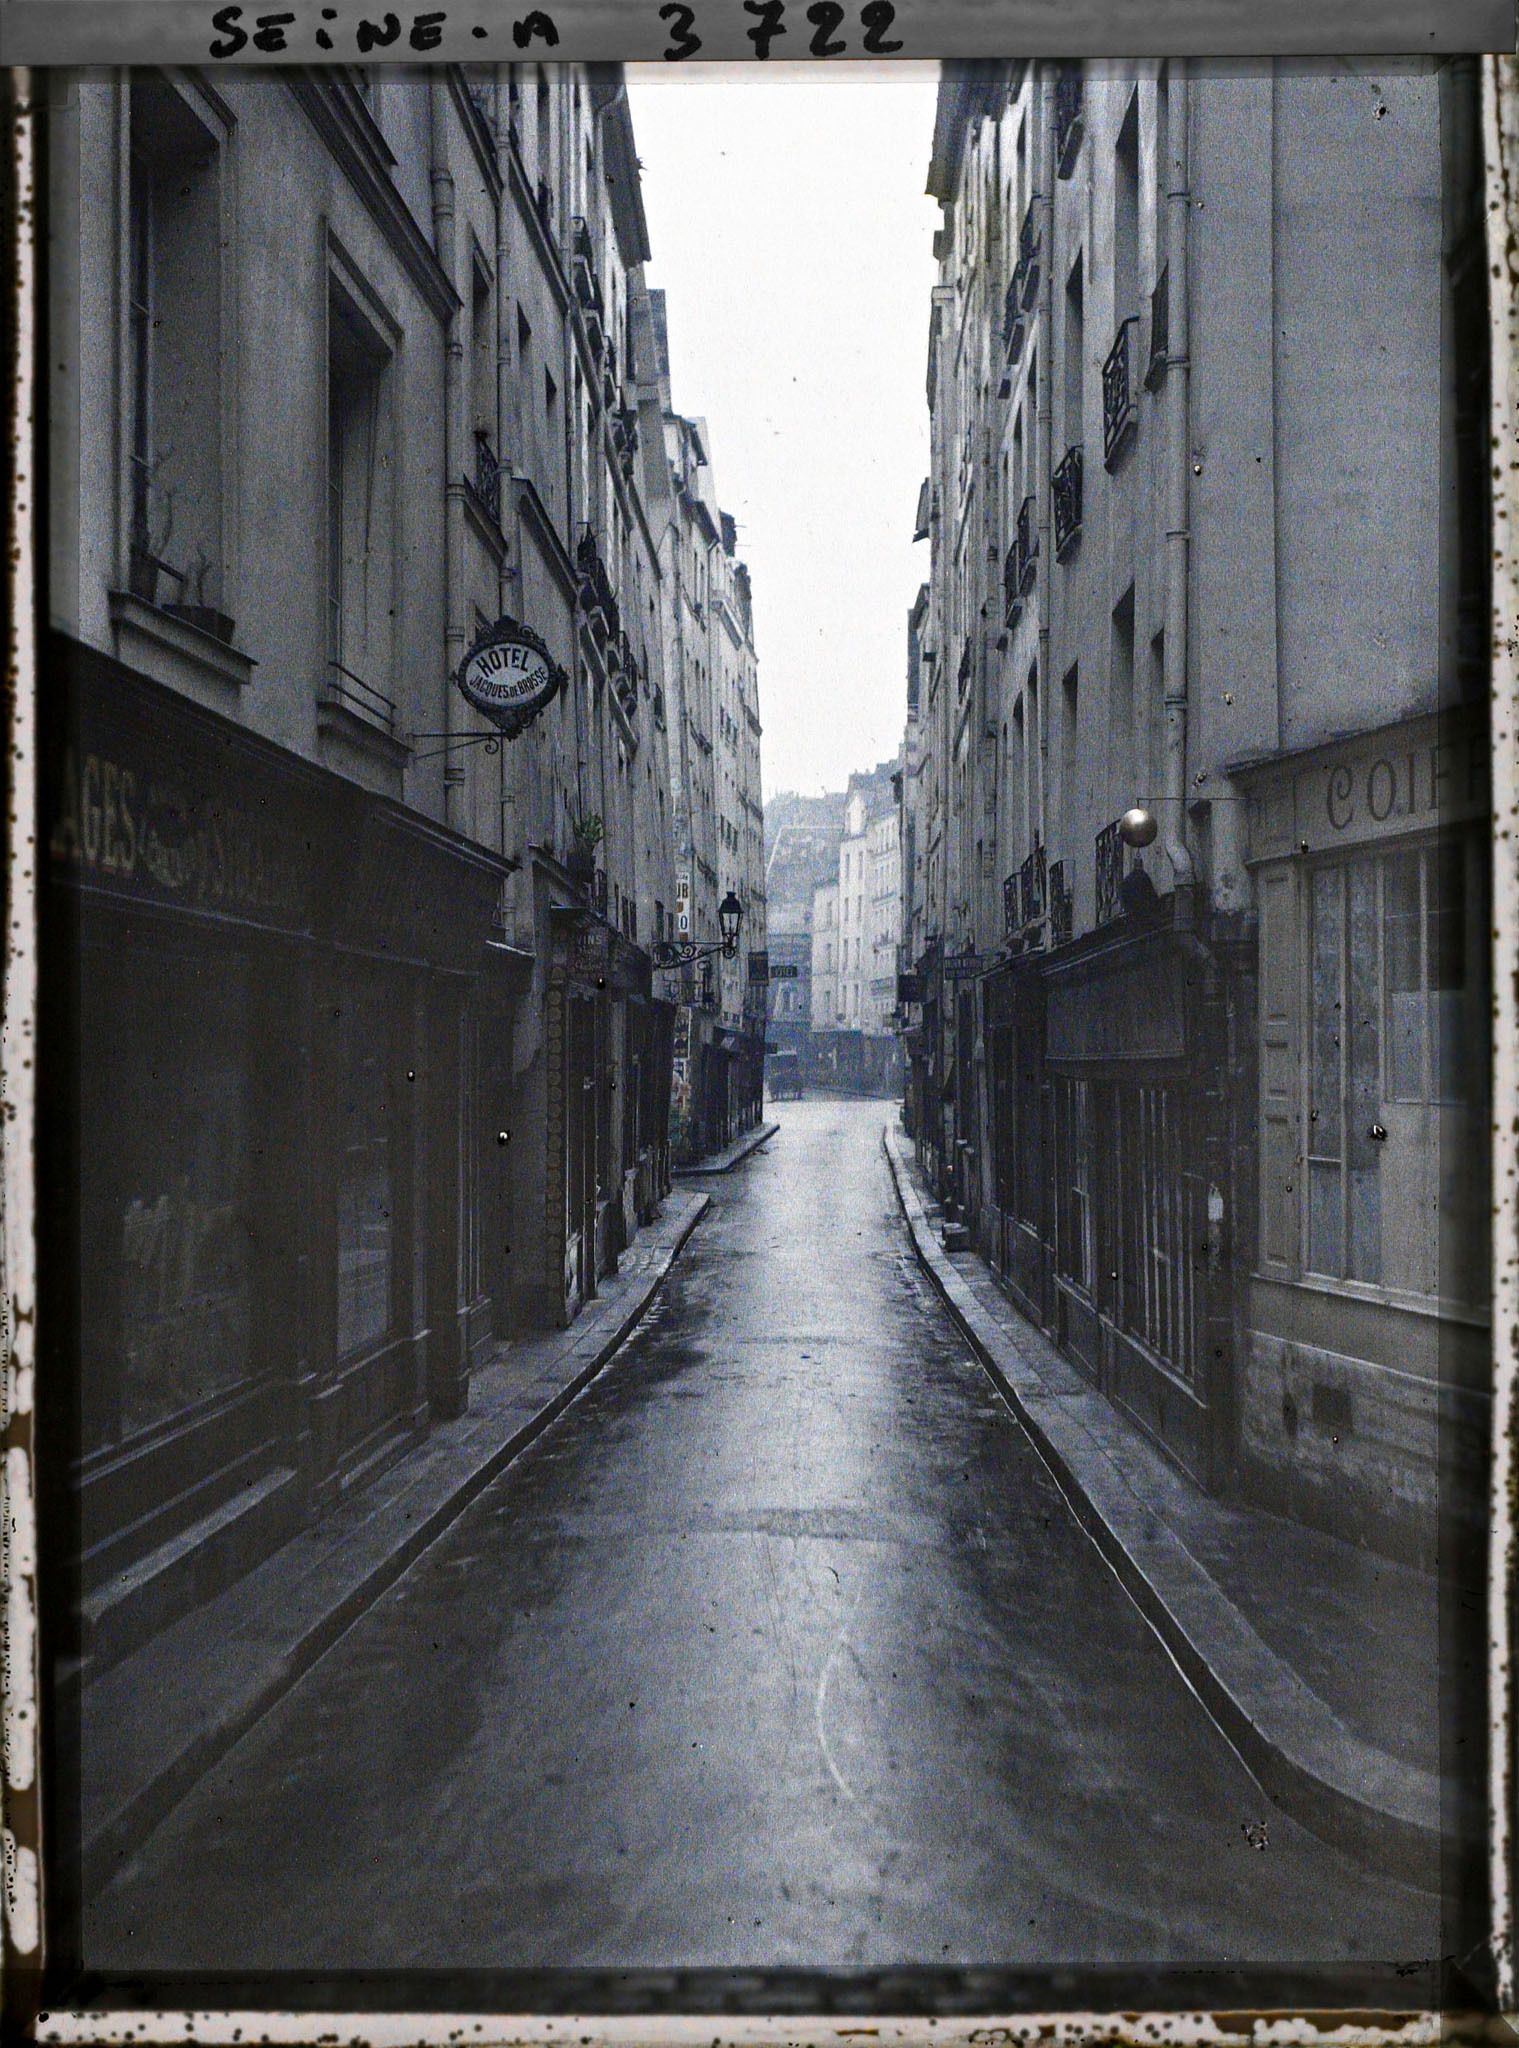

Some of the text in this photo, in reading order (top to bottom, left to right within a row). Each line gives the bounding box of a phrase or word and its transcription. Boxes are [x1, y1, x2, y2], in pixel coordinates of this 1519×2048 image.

[475, 647, 530, 678] HOTEL
[469, 674, 509, 699] JACQUES
[517, 666, 549, 695] BROSSE
[575, 934, 603, 945] VINS
